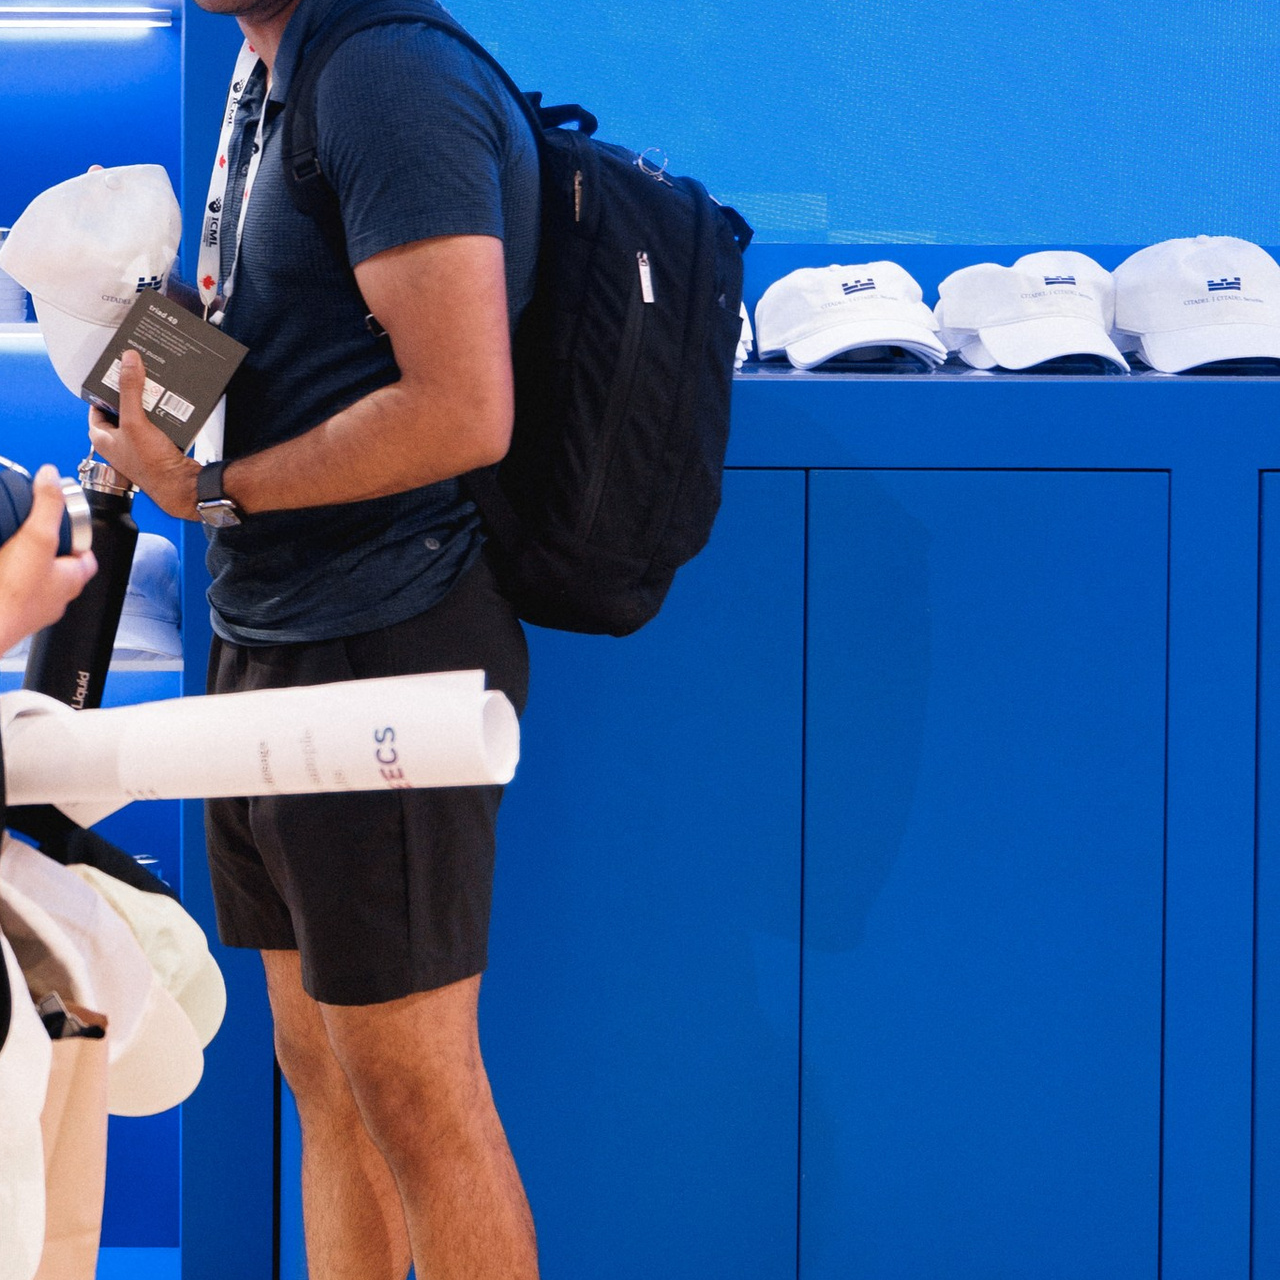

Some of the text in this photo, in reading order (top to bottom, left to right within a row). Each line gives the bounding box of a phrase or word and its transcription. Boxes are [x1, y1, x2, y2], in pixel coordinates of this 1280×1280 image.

[208, 216, 220, 249] ICML
[1183, 297, 1209, 306] CITADEL
[1216, 294, 1242, 302] CITADEL
[148, 304, 179, 325] triad 49
[145, 347, 166, 364] puzzle
[70, 670, 91, 711] Liquid
